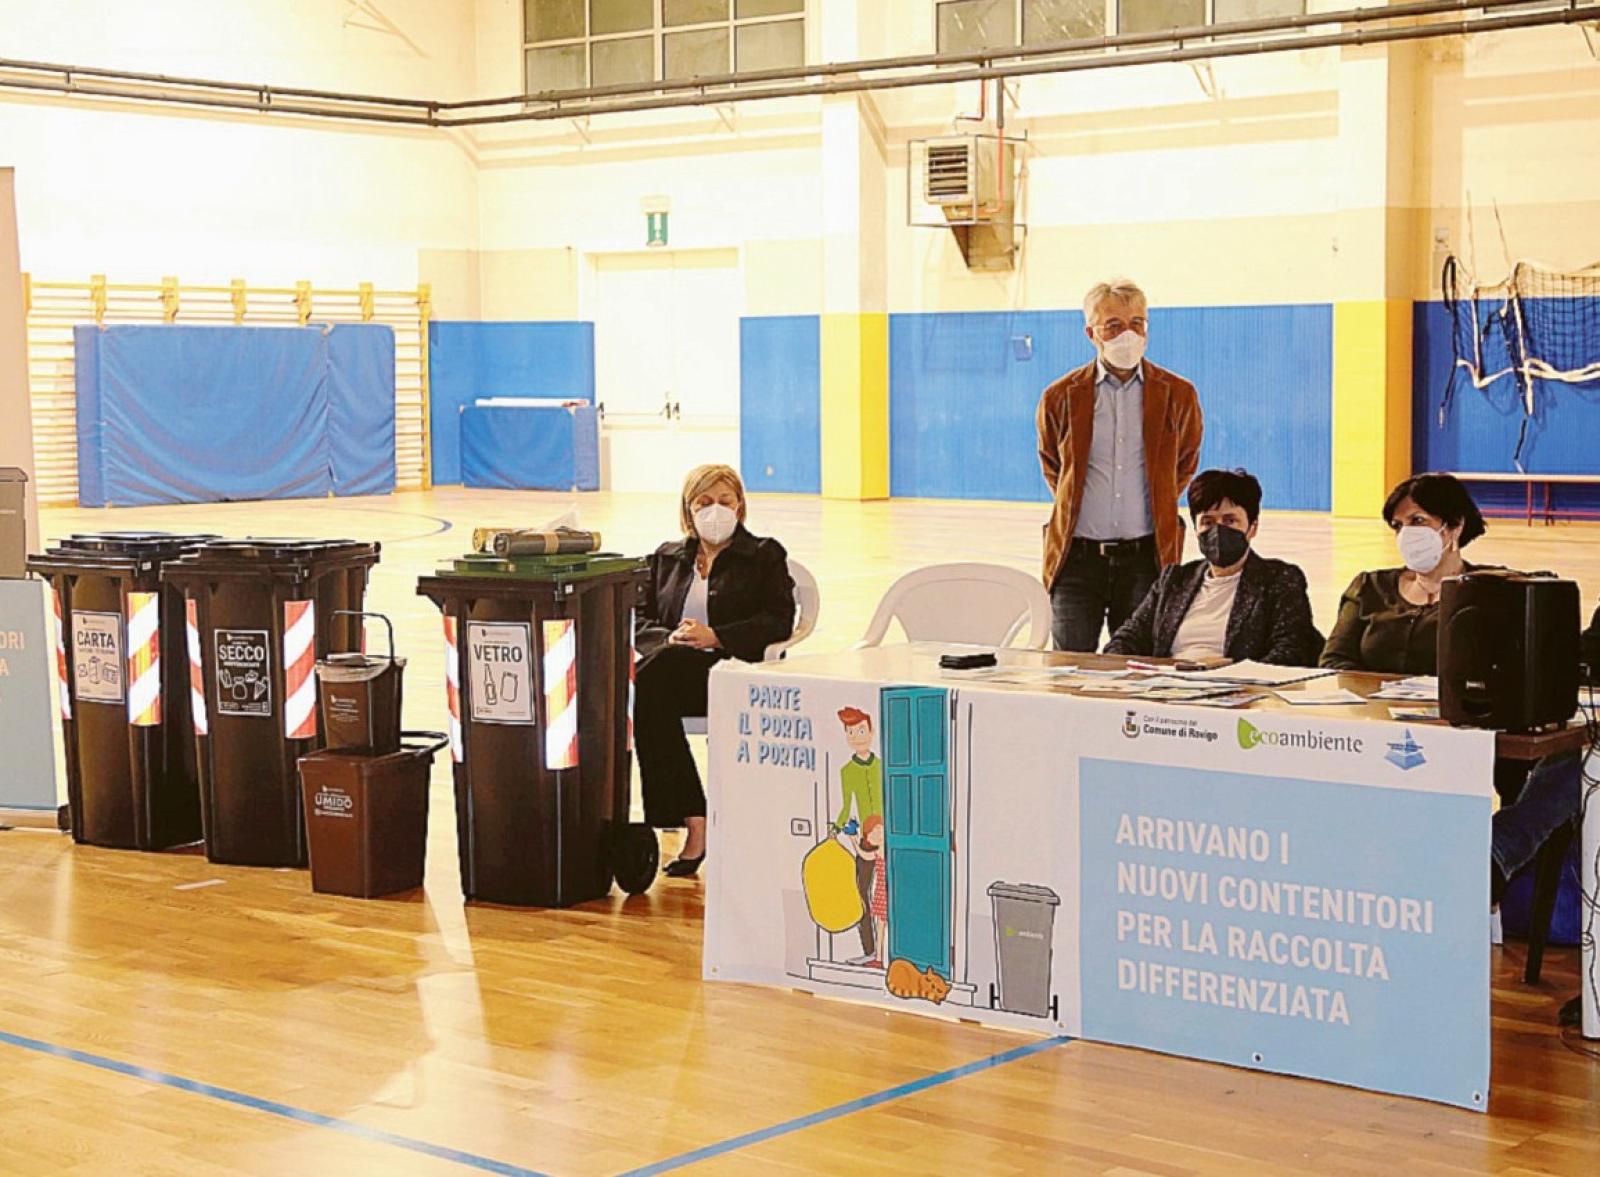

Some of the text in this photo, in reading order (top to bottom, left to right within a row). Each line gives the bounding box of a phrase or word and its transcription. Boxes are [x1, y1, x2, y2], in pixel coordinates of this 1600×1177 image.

[77, 630, 116, 649] CARTA
[219, 645, 264, 661] SECCO
[473, 643, 523, 663] VETRO
[749, 685, 801, 711] PARTE
[738, 712, 813, 740] IL PORTA
[1143, 723, 1218, 742] Comune di Rovigo
[1249, 729, 1363, 753] ecoambiente
[737, 740, 816, 772] A PORTA!
[315, 792, 353, 809] UMIDO
[1115, 813, 1289, 865] ARRIVANO I
[1117, 861, 1434, 934] NUOVI CONTENITORI
[1117, 910, 1390, 981] PER LA RACCOLTA
[1118, 958, 1350, 1026] DIFFERENZIATA
